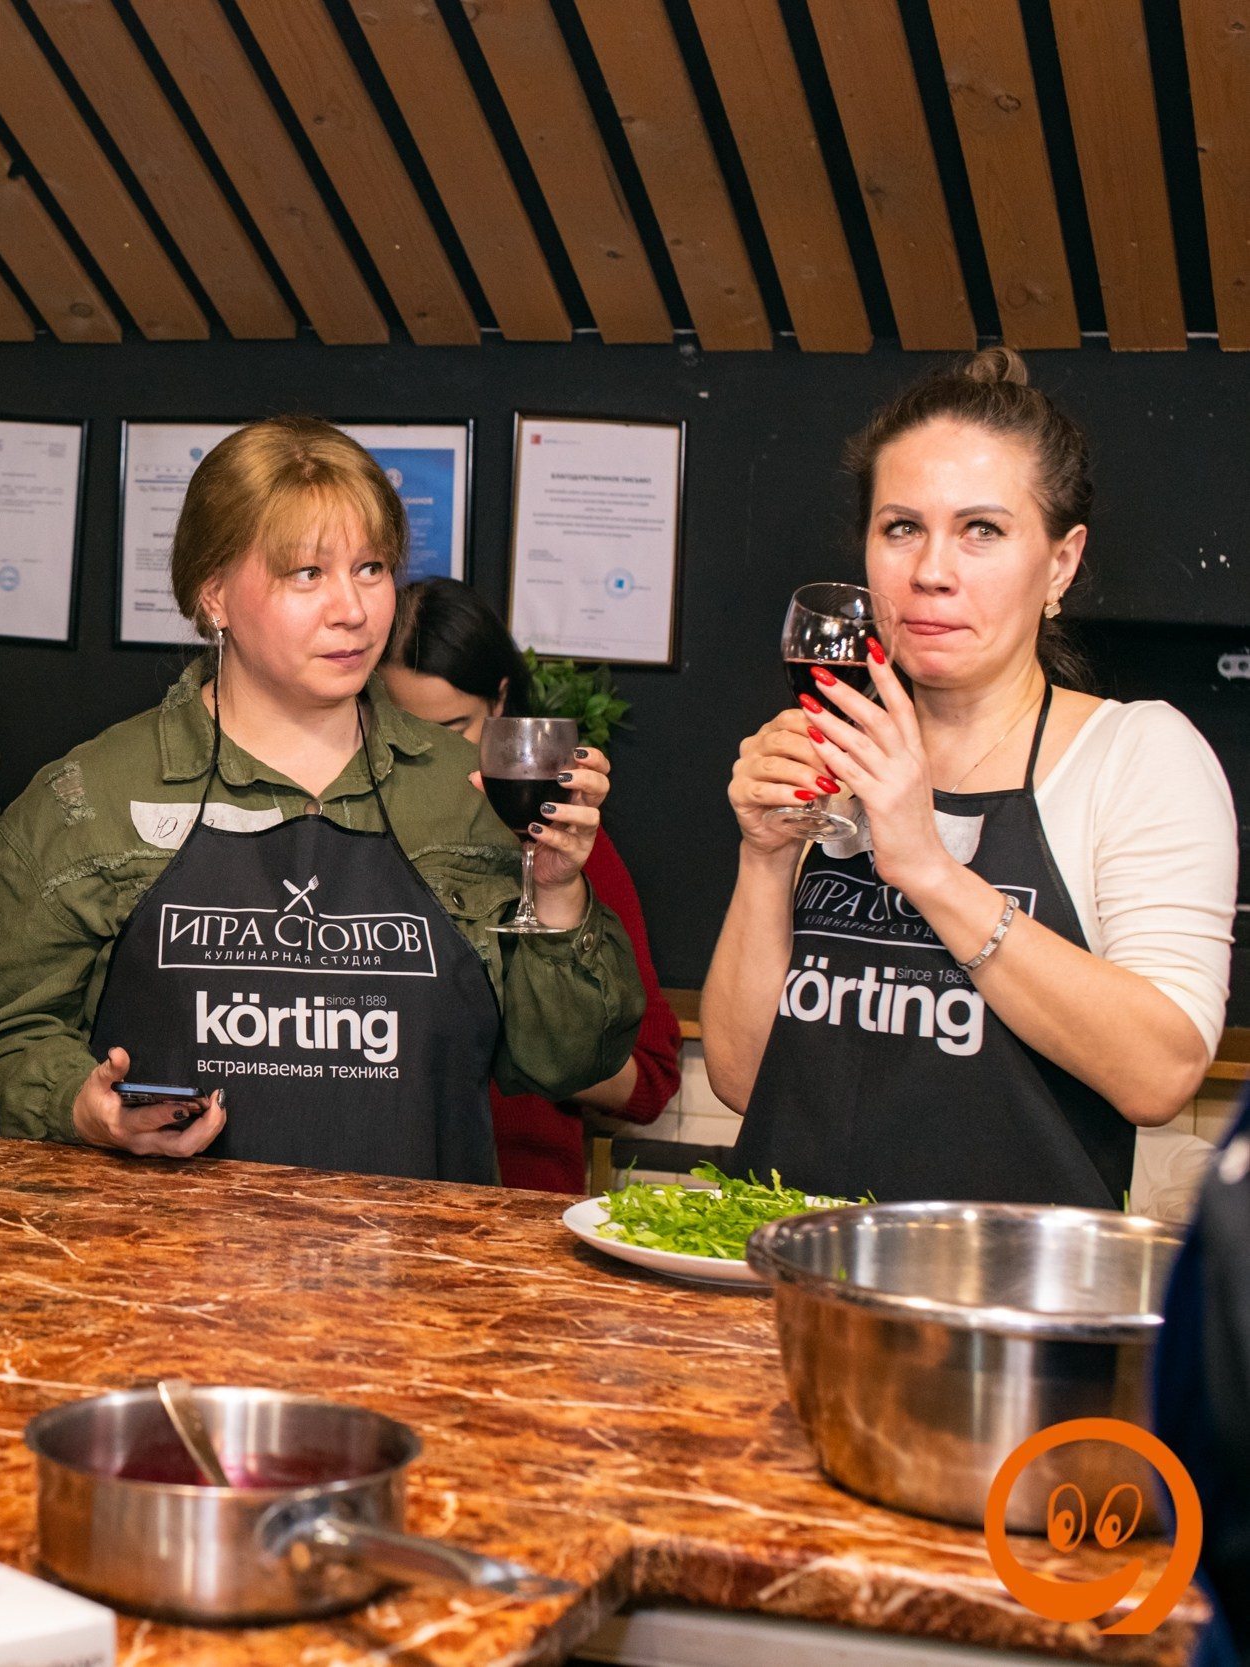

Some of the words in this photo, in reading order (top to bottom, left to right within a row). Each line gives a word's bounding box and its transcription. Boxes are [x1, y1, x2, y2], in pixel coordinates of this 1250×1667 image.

[796, 879, 863, 917] ИГРА
[169, 913, 265, 946] ИГРА
[274, 914, 422, 953] СТОЛОВ
[804, 914, 886, 934] КУЛИНАРНАЯ
[888, 923, 935, 940] СТУД
[204, 950, 311, 965] КУЛИНАРНАЯ
[320, 955, 382, 967] СТУДИЯ
[896, 965, 933, 982] since
[325, 994, 356, 1006] since
[359, 995, 387, 1007] 1889
[196, 990, 398, 1064] körting
[197, 1060, 323, 1078] встраиваемая
[329, 1064, 399, 1080] техника
